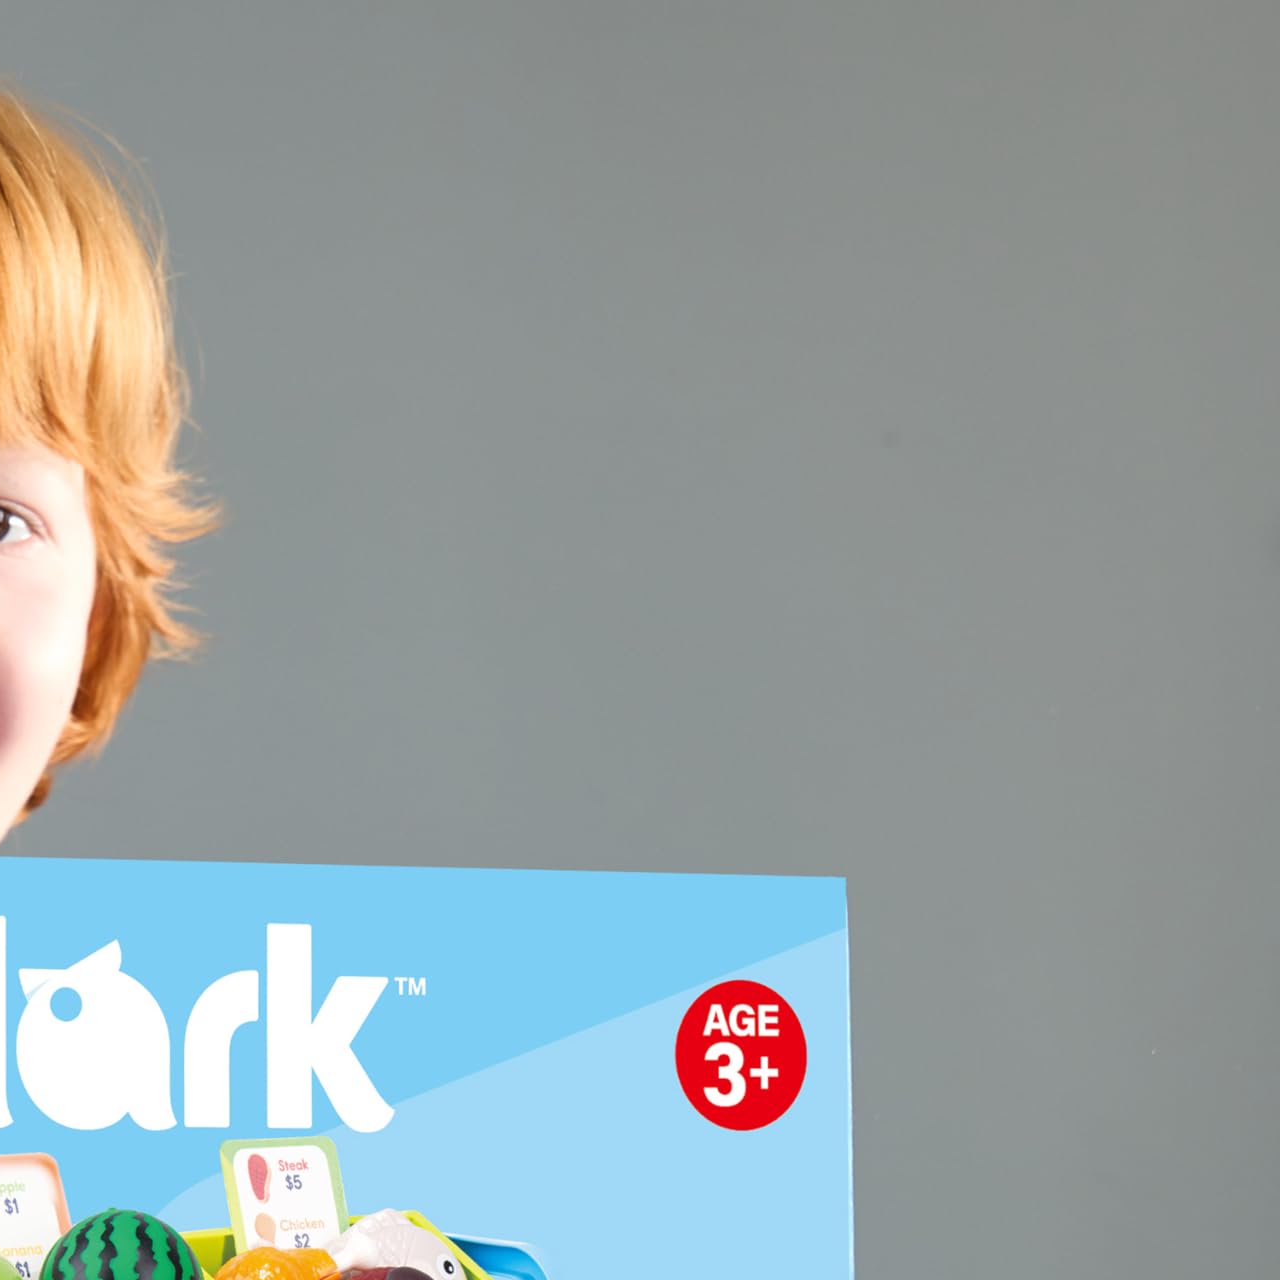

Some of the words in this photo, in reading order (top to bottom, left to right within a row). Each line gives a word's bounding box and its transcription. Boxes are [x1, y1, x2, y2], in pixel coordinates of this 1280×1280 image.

[703, 1003, 780, 1037] AGE
[703, 1041, 780, 1108] 3+
[278, 1158, 309, 1173] Steak
[285, 1174, 303, 1191] $5
[4, 1198, 20, 1215] $1
[280, 1217, 325, 1232] Chicken
[294, 1233, 311, 1249] $2
